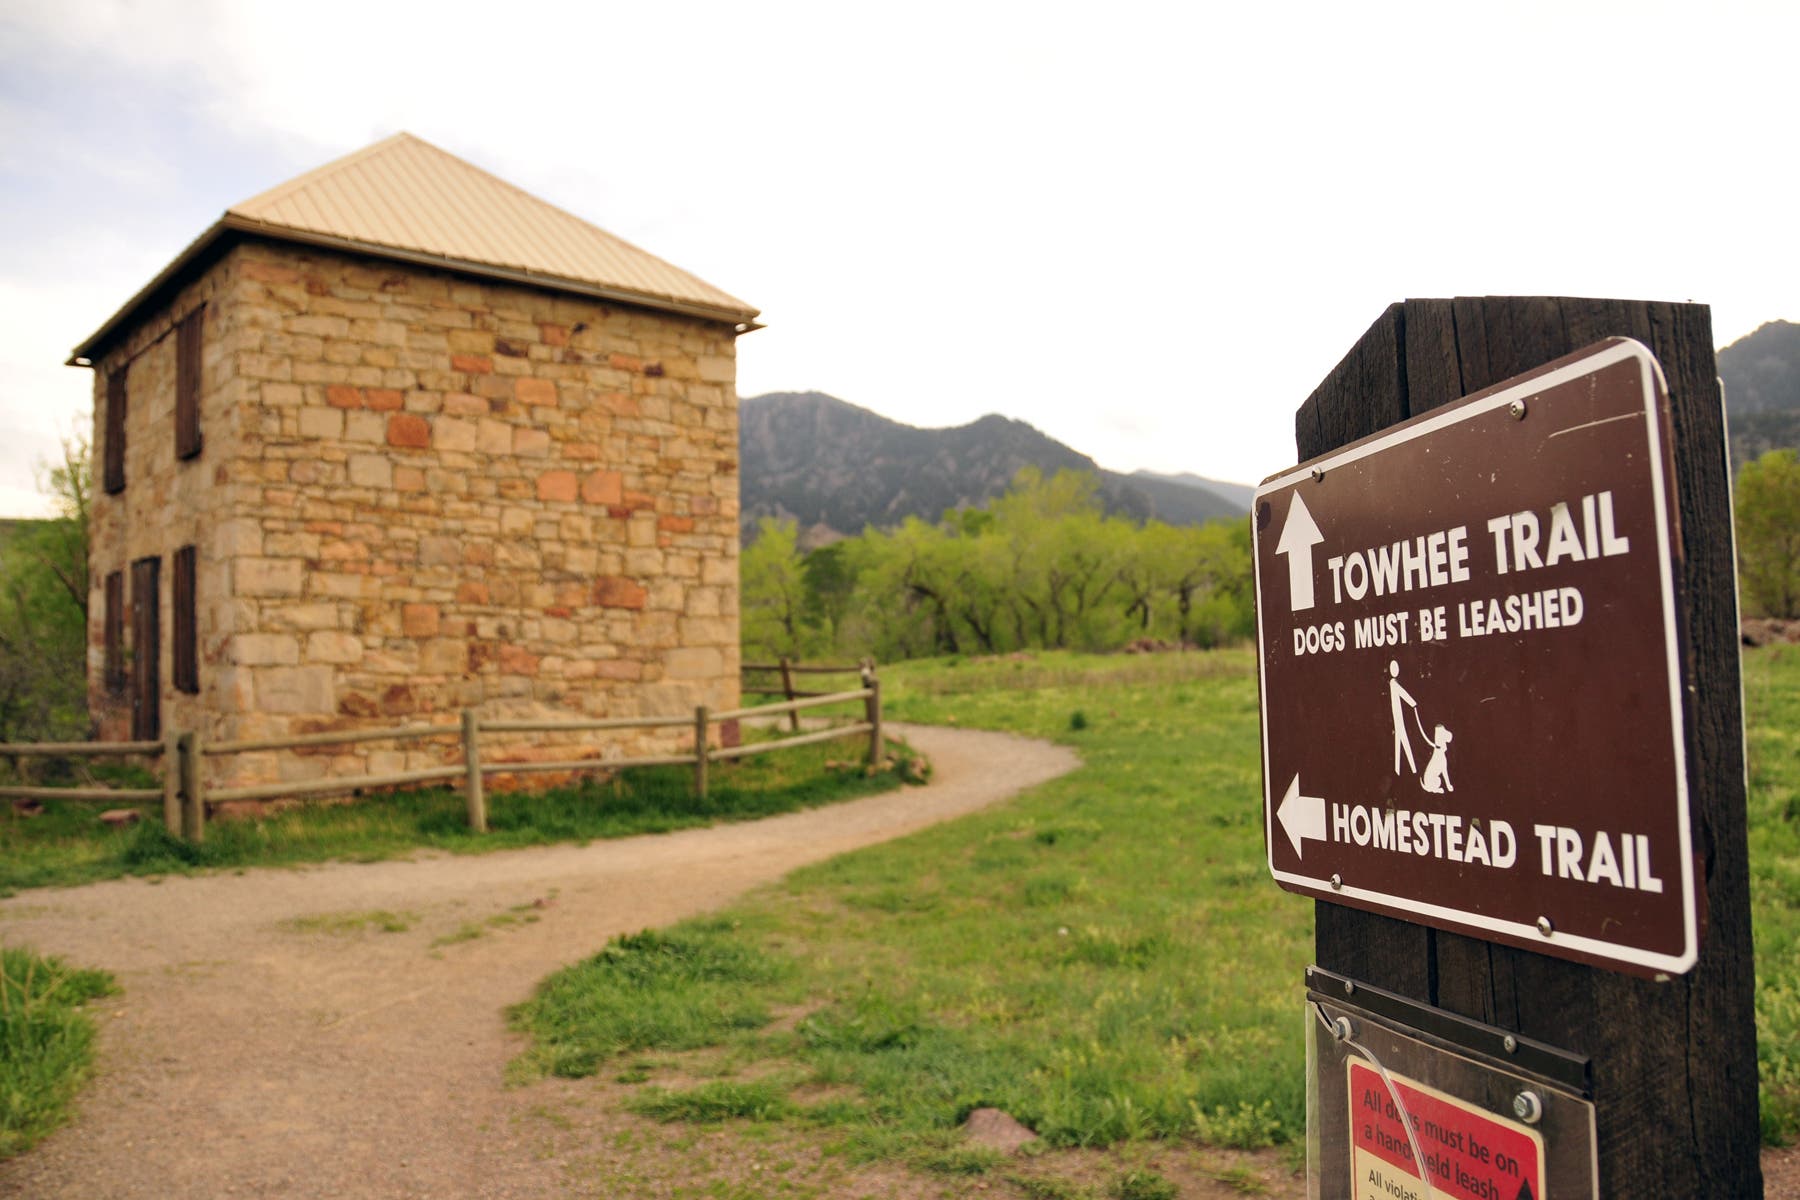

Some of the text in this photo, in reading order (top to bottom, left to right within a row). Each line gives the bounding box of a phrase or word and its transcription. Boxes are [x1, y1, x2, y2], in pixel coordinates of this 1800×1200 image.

[1328, 491, 1630, 604] TOWHEE TRAIL
[1293, 587, 1584, 656] DOGS MUST BE LEASHED
[1333, 803, 1663, 894] HOMESTEAD TRAIL
[1364, 1089, 1381, 1114] All
[1425, 1121, 1464, 1152] must
[1469, 1133, 1489, 1164] be
[1495, 1153, 1519, 1178] on
[1365, 1124, 1373, 1140] a
[1455, 1162, 1499, 1200] leash
[1368, 1169, 1382, 1188] All
